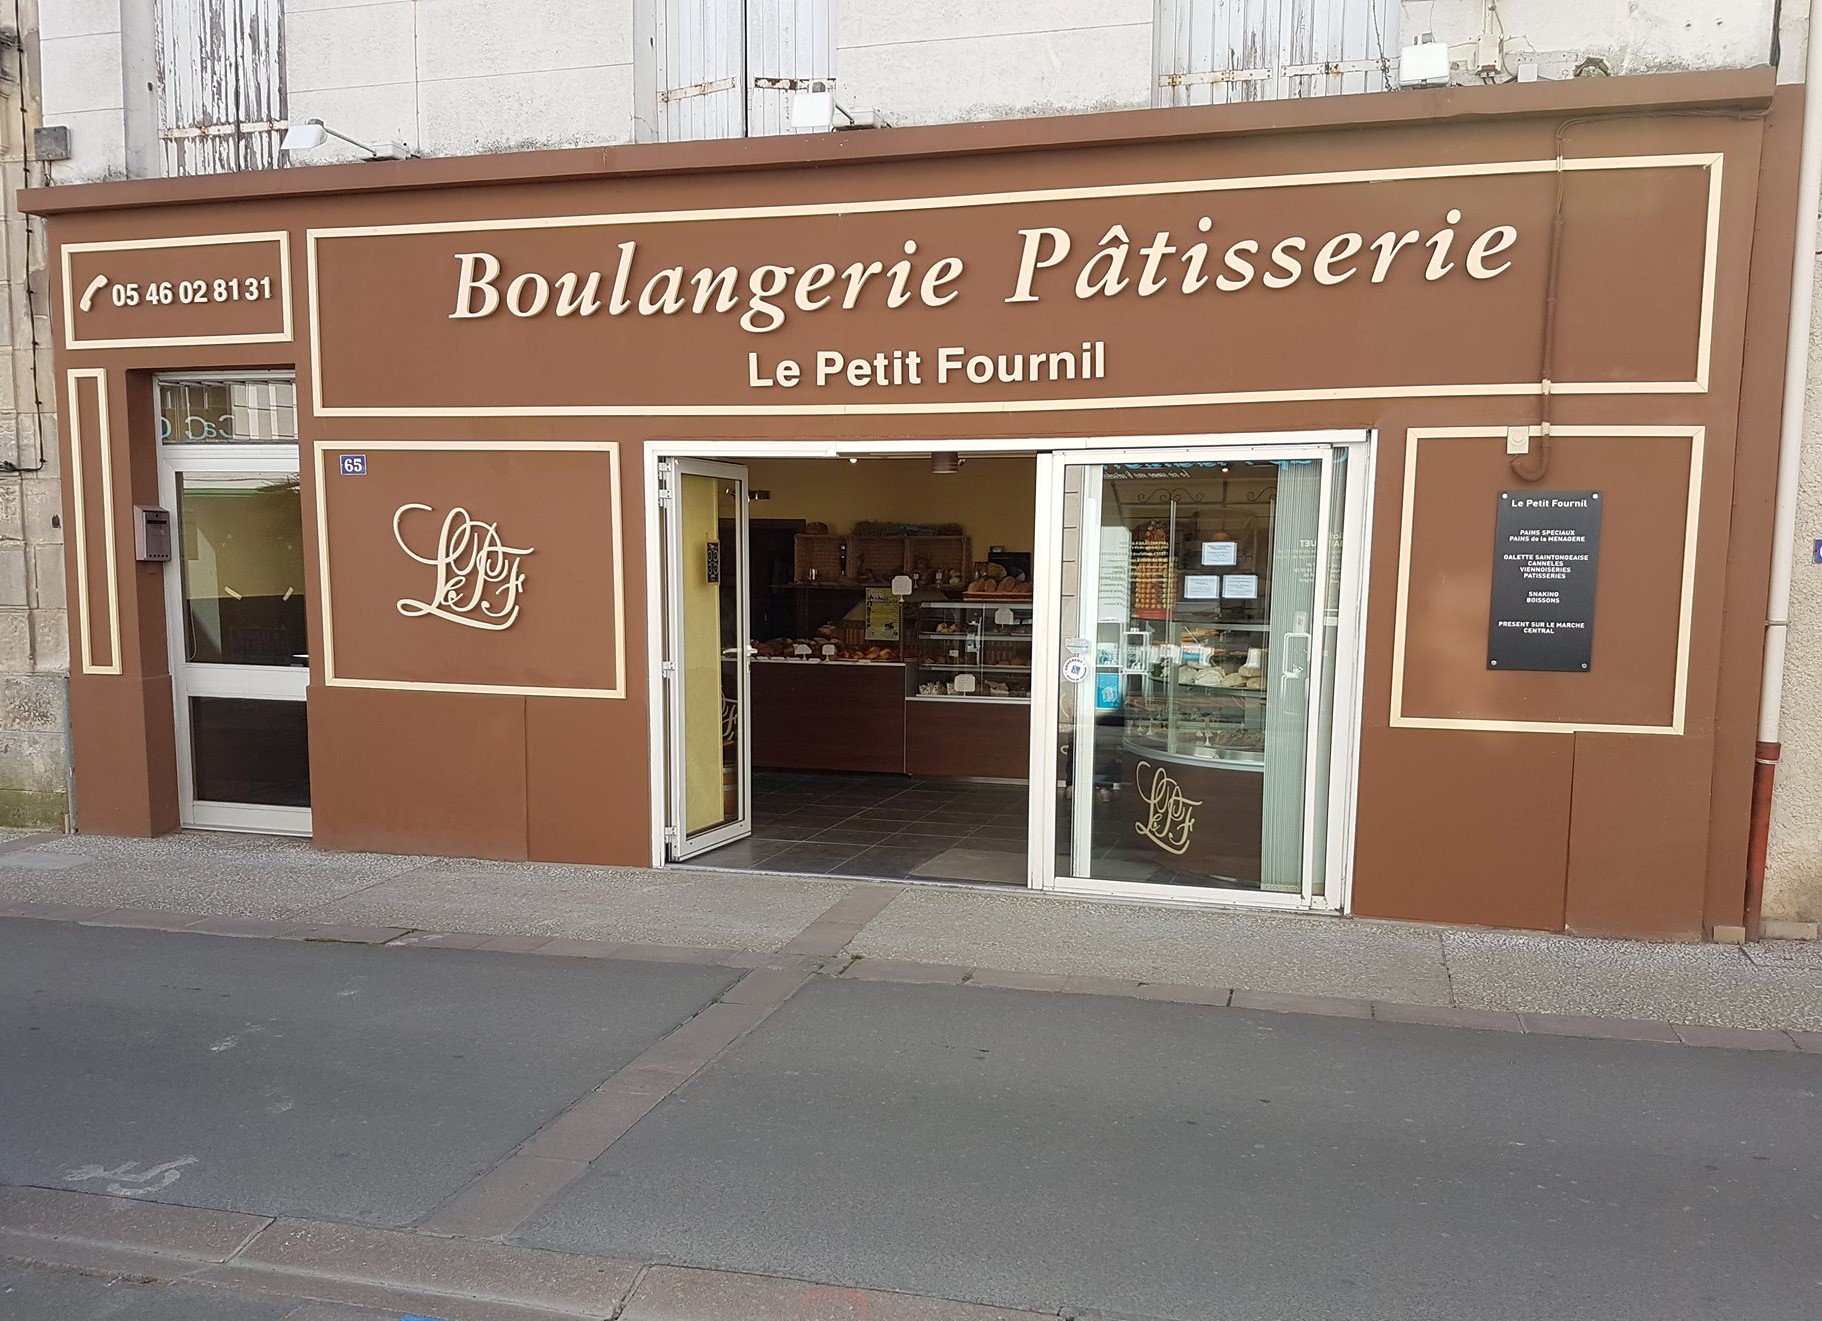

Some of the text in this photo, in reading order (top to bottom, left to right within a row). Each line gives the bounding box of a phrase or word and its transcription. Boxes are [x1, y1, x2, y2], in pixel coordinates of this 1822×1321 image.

[448, 209, 1518, 333] Boulangerie Pâtisserie
[112, 276, 271, 306] 05 46 02 81 31
[748, 341, 1105, 387] Le Petit Fournil
[343, 457, 362, 473] 65
[1511, 499, 1588, 508] Le Petit Fournil
